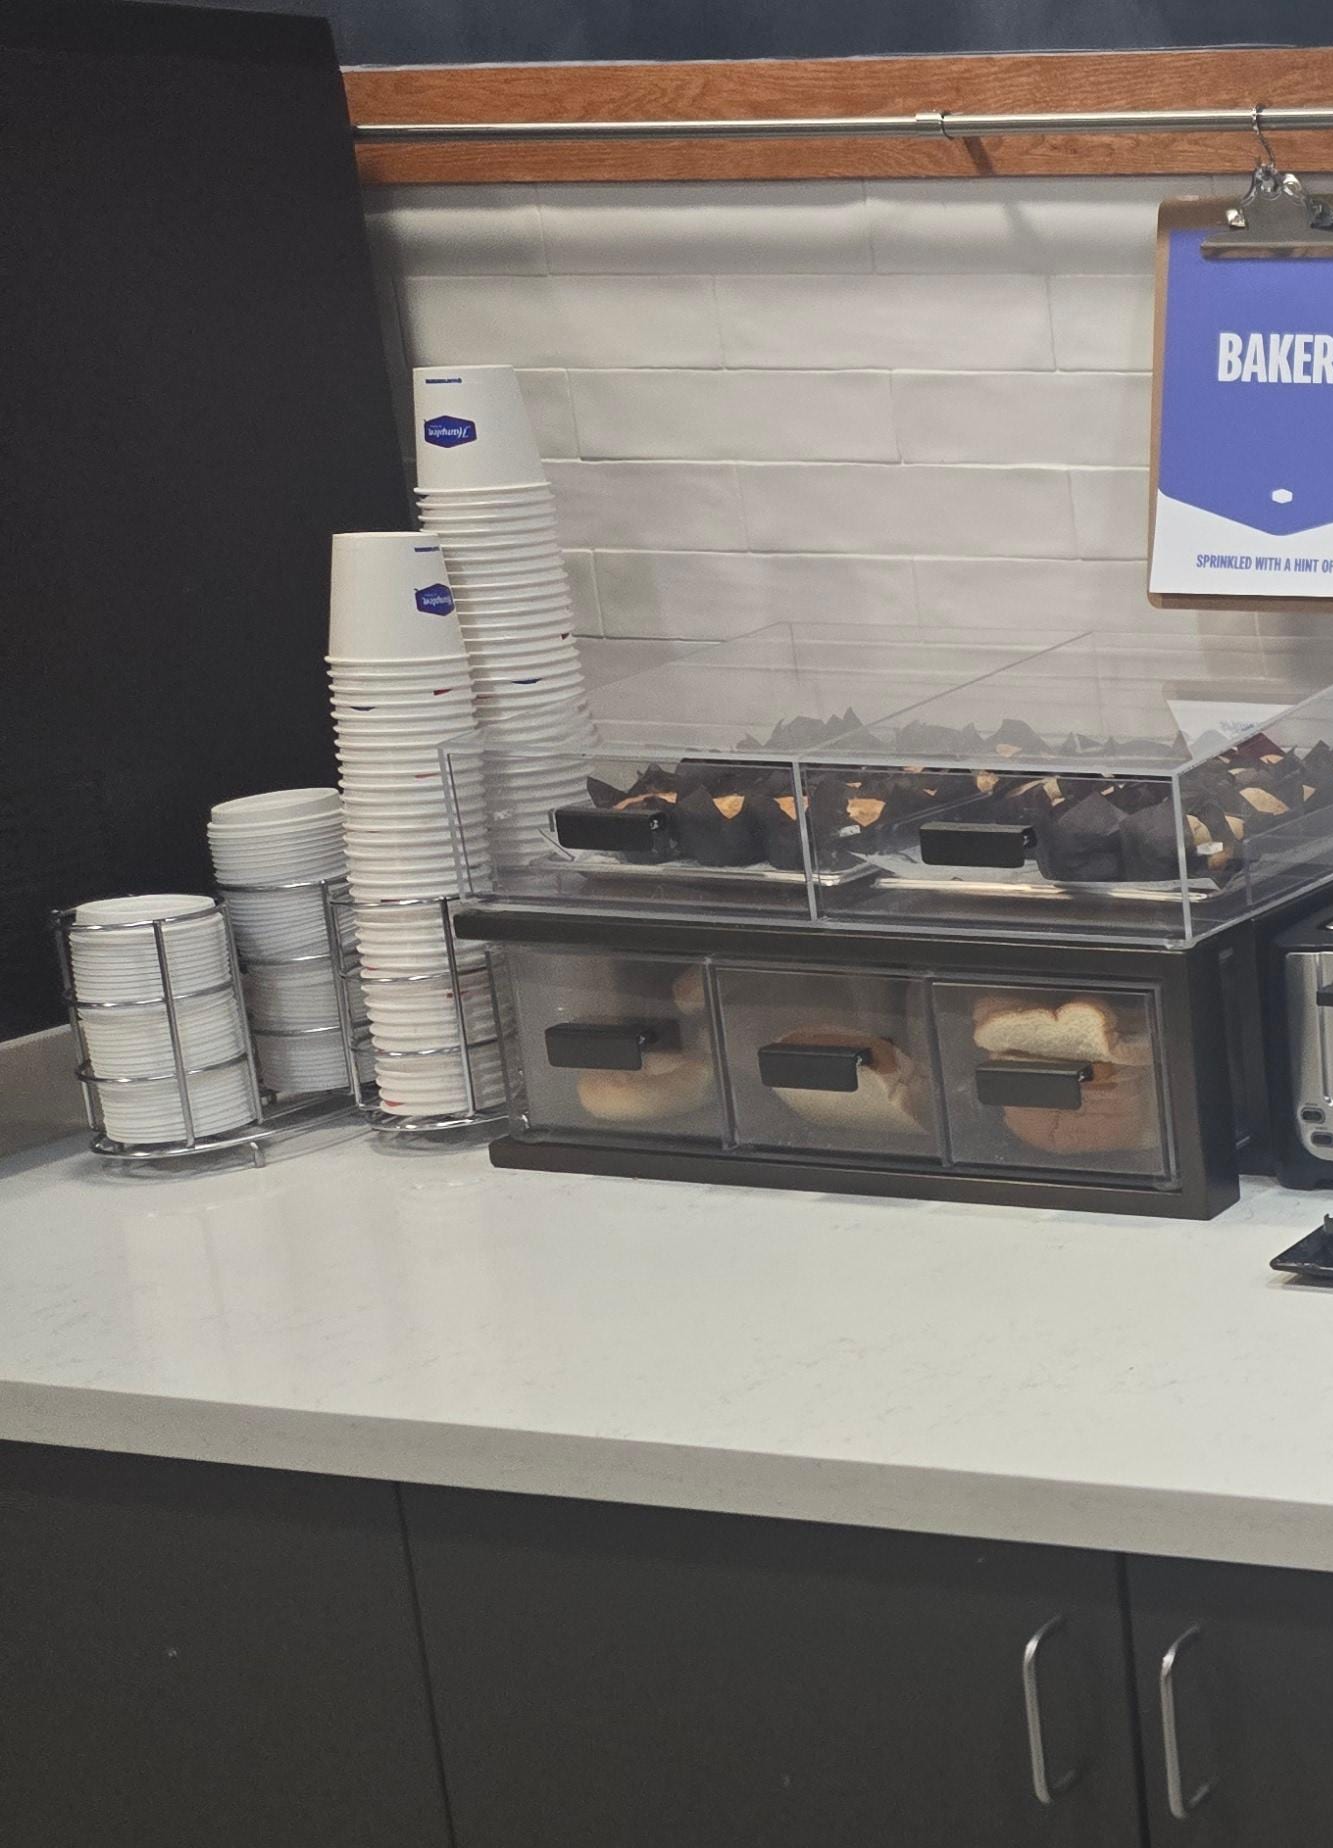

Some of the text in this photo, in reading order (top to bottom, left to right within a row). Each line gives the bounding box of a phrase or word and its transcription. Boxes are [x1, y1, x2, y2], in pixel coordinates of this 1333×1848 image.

[1196, 554, 1252, 570] SPRINKLED
[1255, 556, 1281, 571] WITH
[1284, 558, 1291, 571] A
[1294, 558, 1319, 573] HINT
